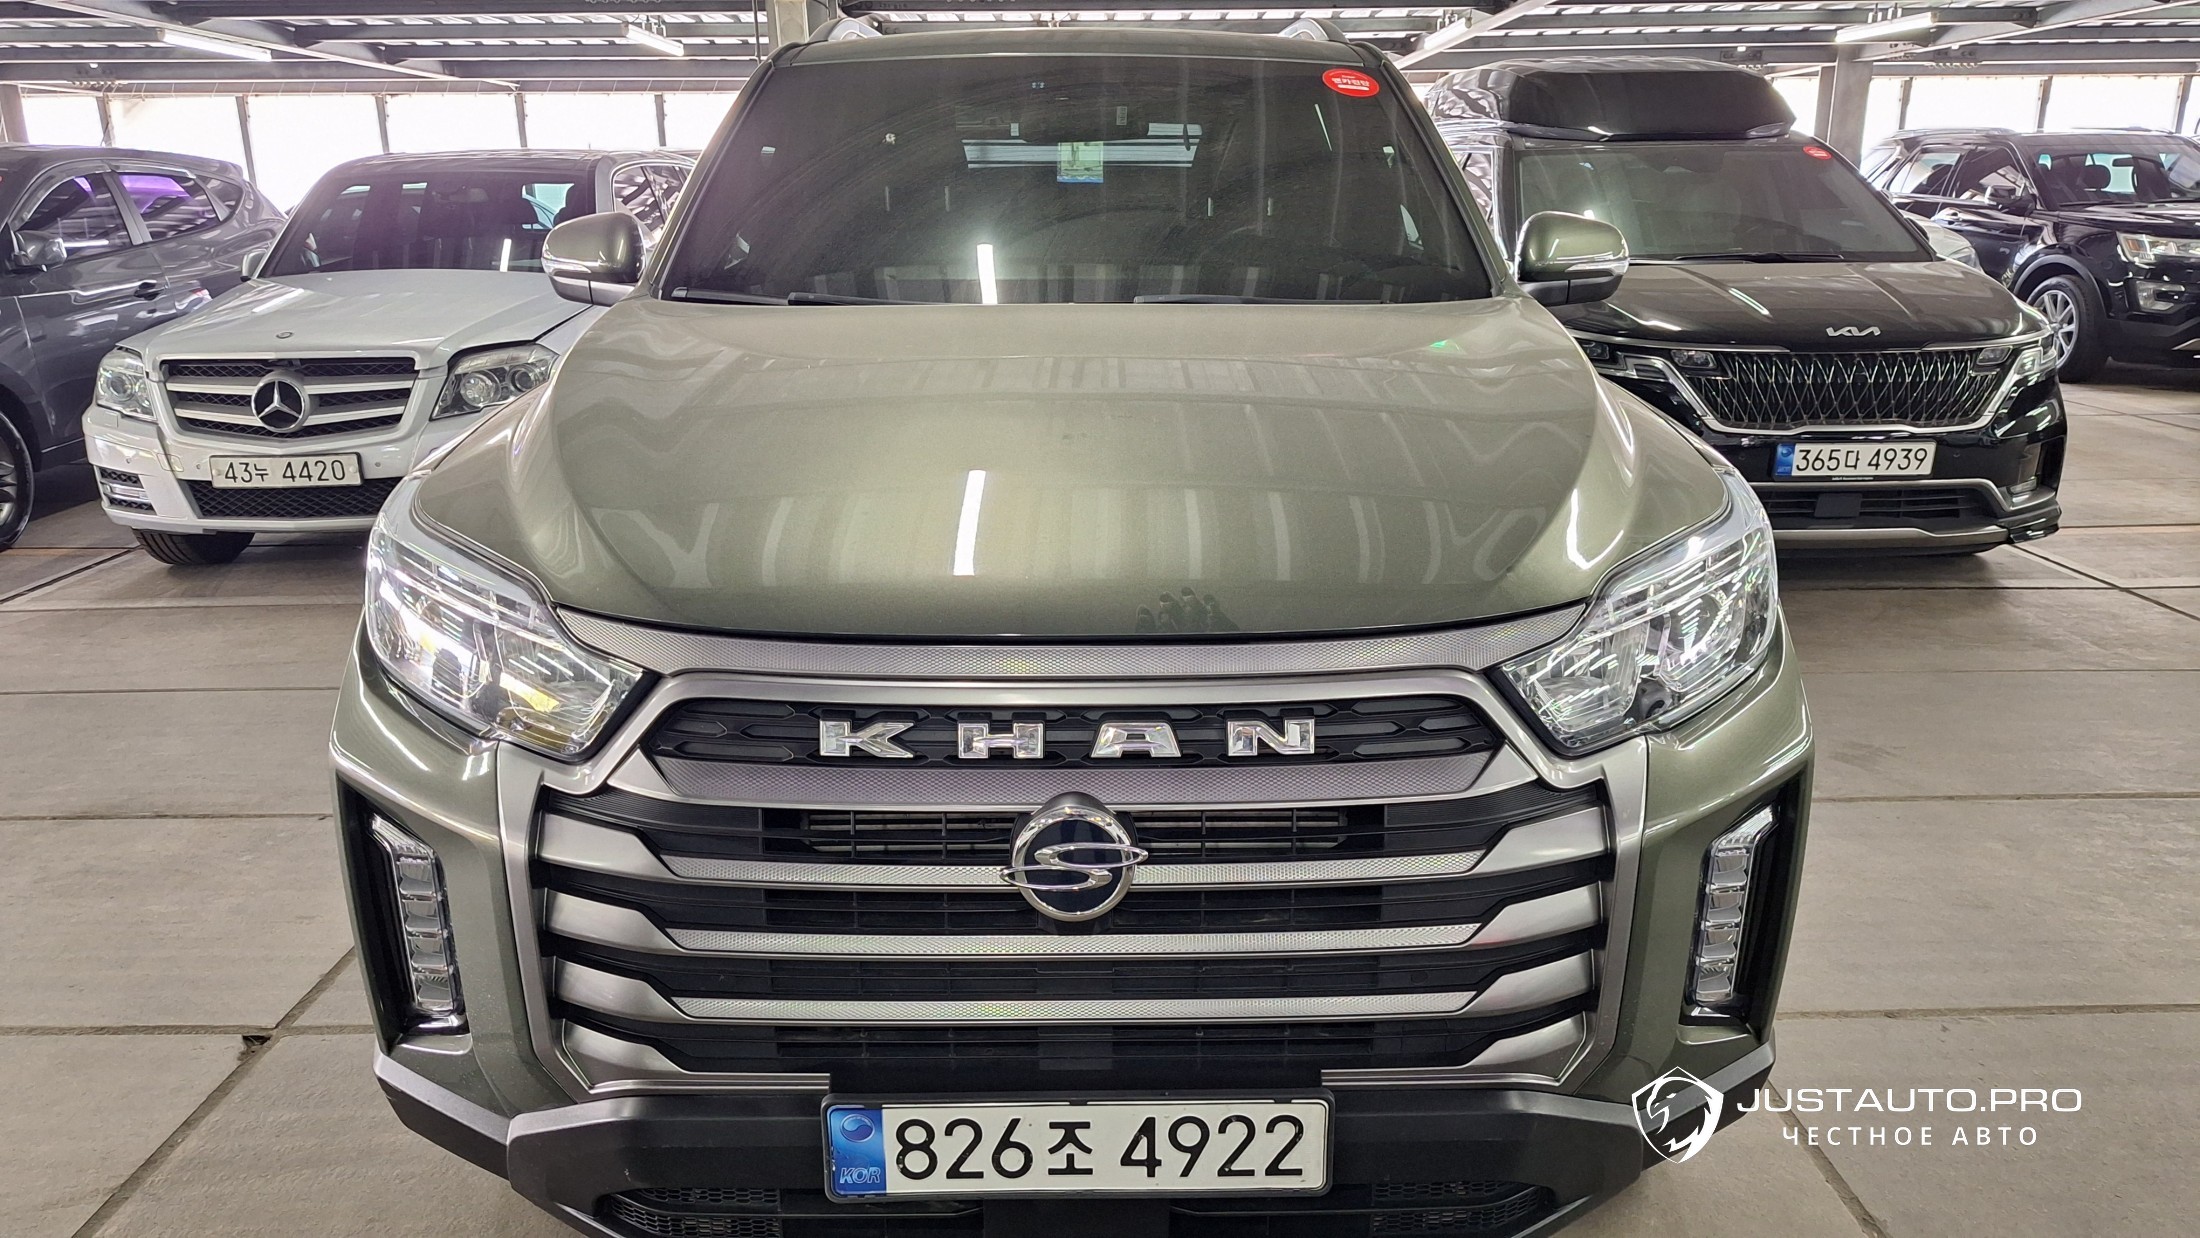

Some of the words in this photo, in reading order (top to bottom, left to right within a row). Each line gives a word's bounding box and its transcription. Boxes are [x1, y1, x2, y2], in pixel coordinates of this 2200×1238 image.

[224, 461, 269, 483] 43누
[282, 459, 346, 483] 4420
[1796, 448, 1860, 472] 365다
[1867, 447, 1928, 471] 4939
[818, 718, 1317, 759] KHAN
[895, 1117, 1094, 1181] 826조
[1119, 1114, 1304, 1178] 4922
[838, 1167, 882, 1184] KOR
